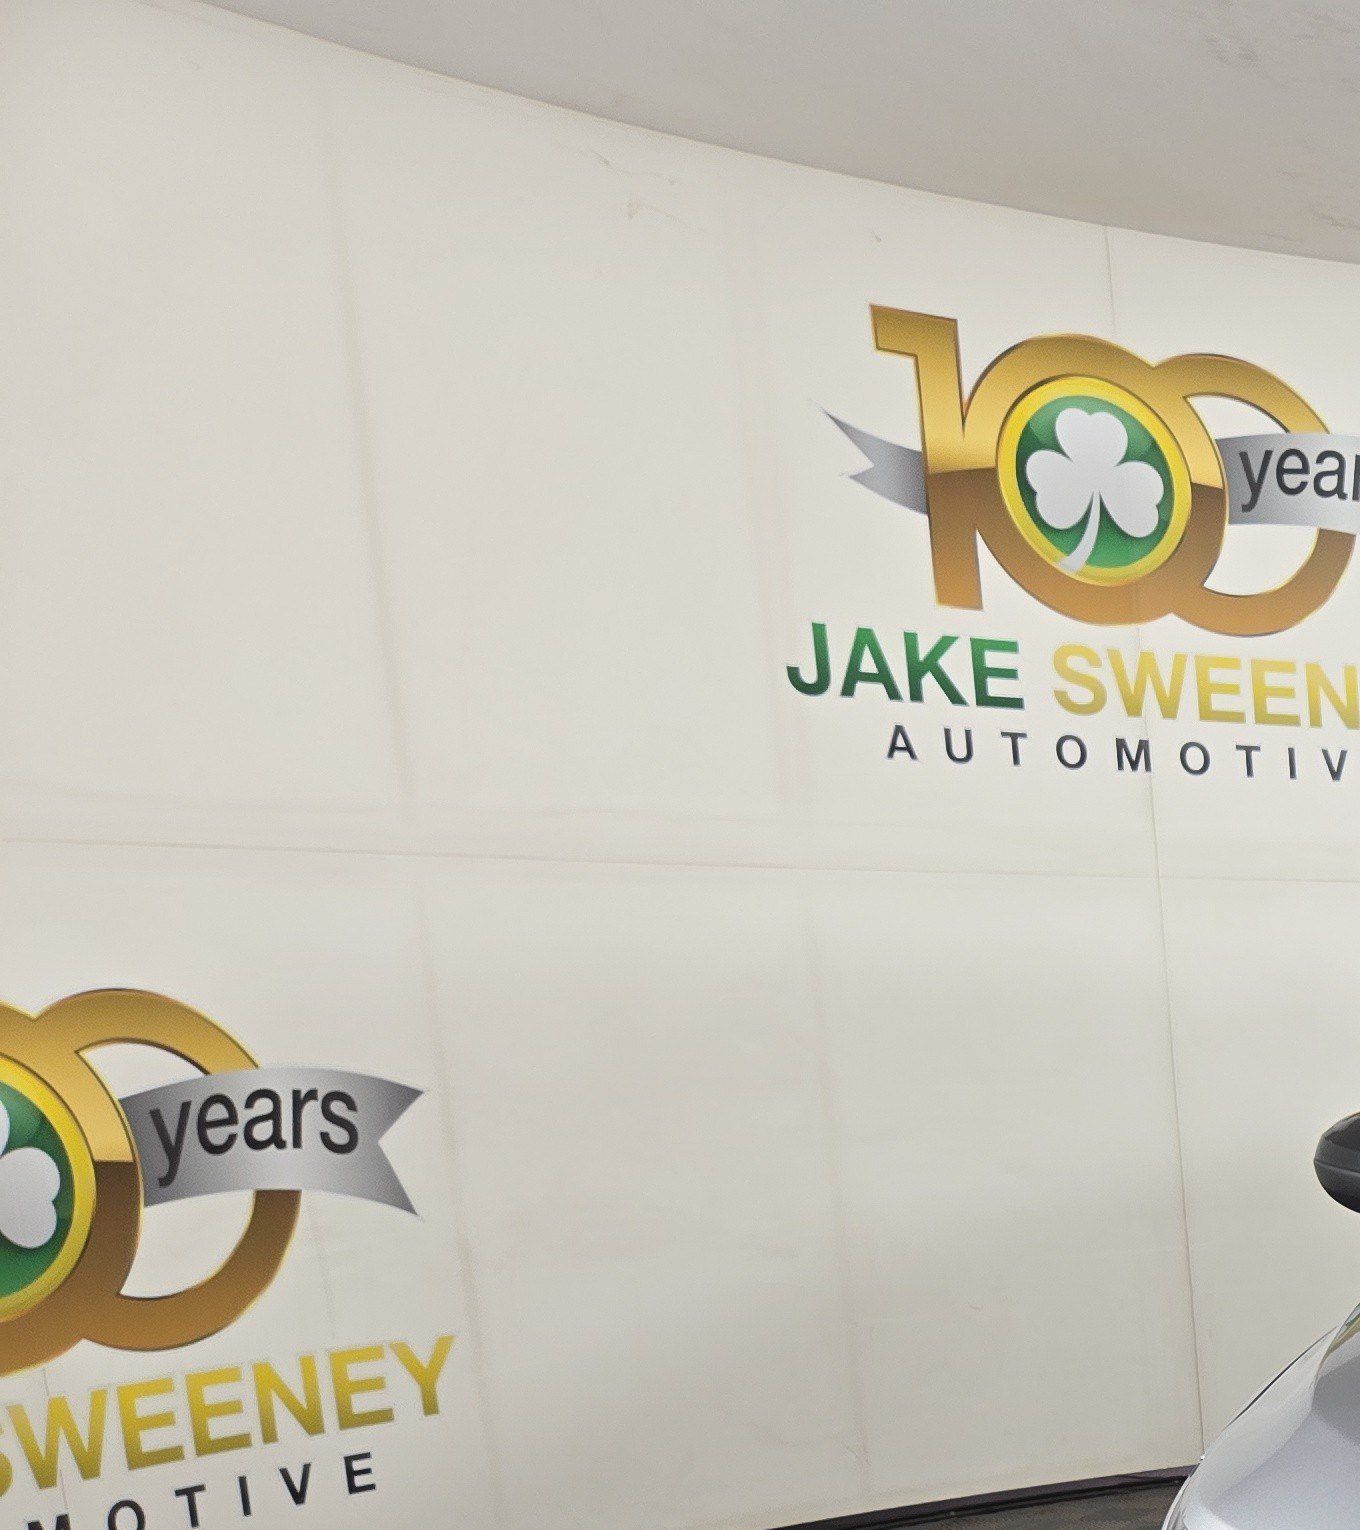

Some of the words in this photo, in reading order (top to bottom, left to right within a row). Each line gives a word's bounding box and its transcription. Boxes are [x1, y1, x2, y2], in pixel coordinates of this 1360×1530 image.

[869, 303, 1357, 638] 100
[787, 622, 1025, 710] JAKE
[148, 1086, 361, 1188] years
[0, 1335, 455, 1497] WEENEY
